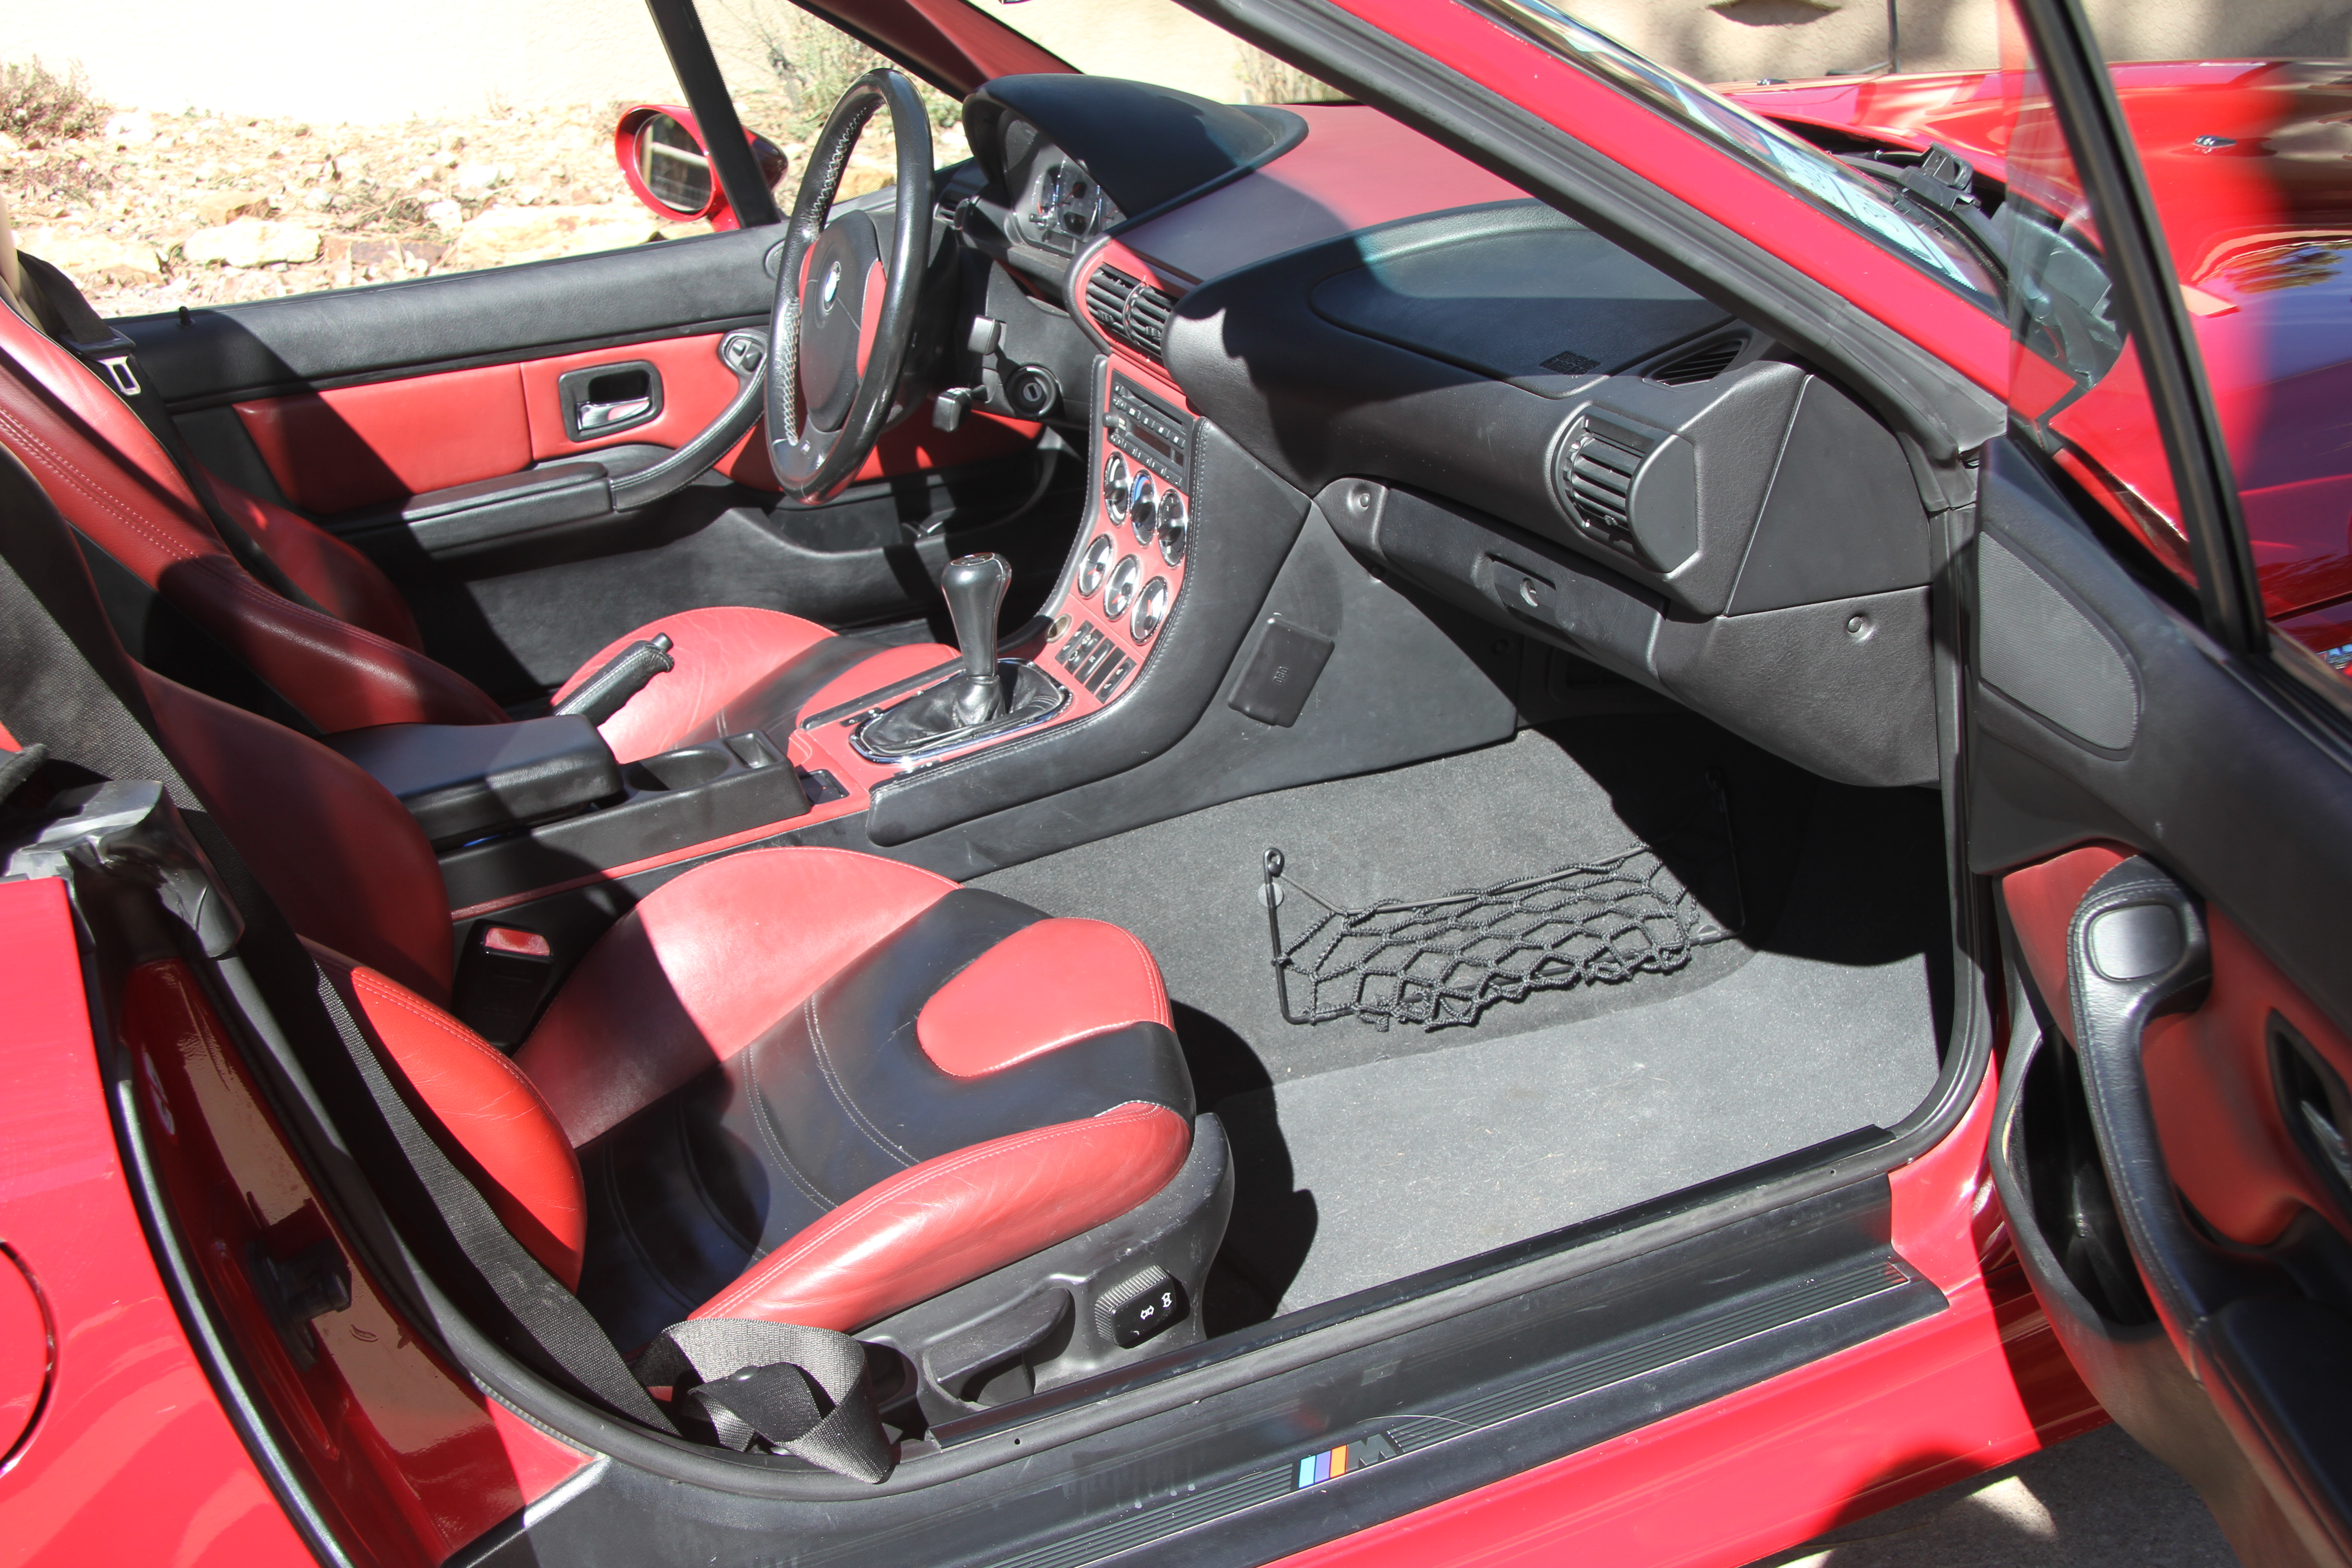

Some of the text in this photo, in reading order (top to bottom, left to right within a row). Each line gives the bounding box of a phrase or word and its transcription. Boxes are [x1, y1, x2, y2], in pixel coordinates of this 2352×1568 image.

[1555, 351, 1602, 370] SRS
[1273, 666, 1289, 684] OBD
[1346, 1433, 1396, 1473] M
